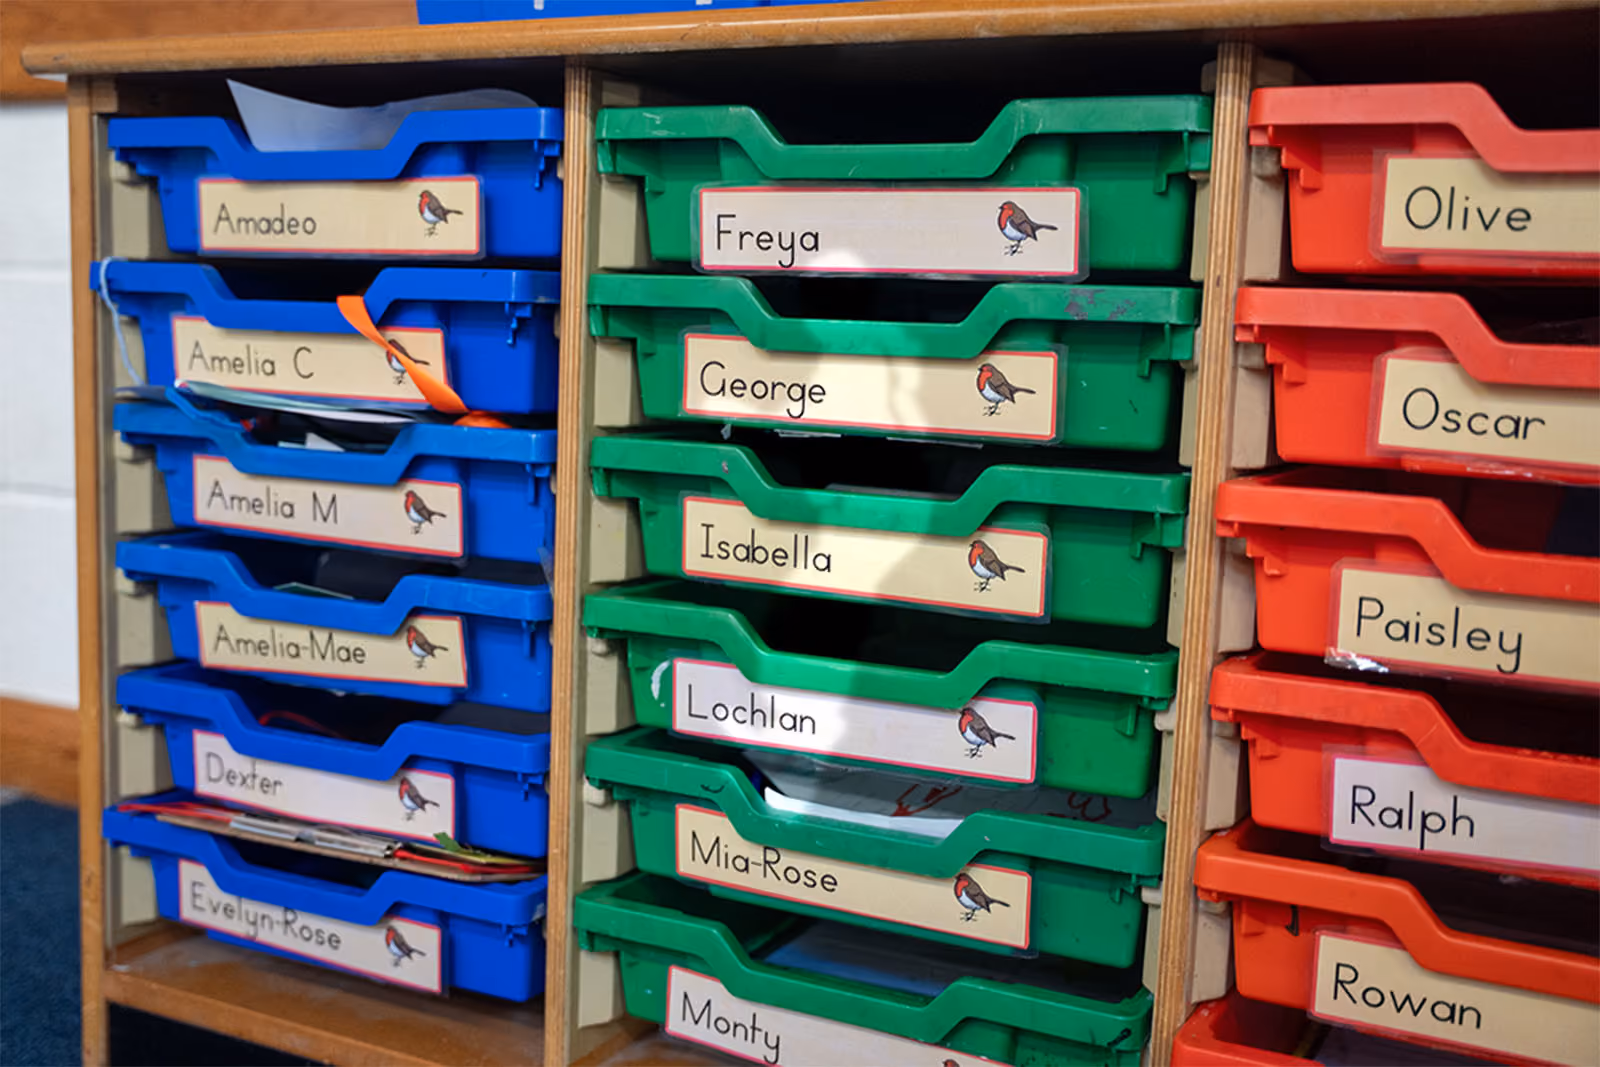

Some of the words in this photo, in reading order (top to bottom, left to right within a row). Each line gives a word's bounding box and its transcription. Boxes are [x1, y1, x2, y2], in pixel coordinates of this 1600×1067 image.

[213, 203, 317, 236] Amadeo
[1405, 185, 1532, 233] Olive
[716, 213, 820, 269] Freya
[188, 341, 276, 378] Amelia
[294, 346, 314, 380] C
[699, 360, 827, 419] George
[1402, 387, 1546, 441] Oscar
[207, 479, 295, 519] Amelia
[312, 493, 339, 525] M
[701, 522, 832, 574] Isabella
[213, 624, 366, 665] Amelia-Mae
[1357, 596, 1523, 674] Paisley
[688, 683, 817, 736] Lochlan
[206, 752, 284, 796] Dexter
[1351, 785, 1475, 851] Ralph
[691, 830, 838, 894] Mia-Rose
[191, 881, 341, 951] Evelyn-Rose
[1333, 962, 1482, 1030] Rowan
[682, 991, 781, 1066] Monty
